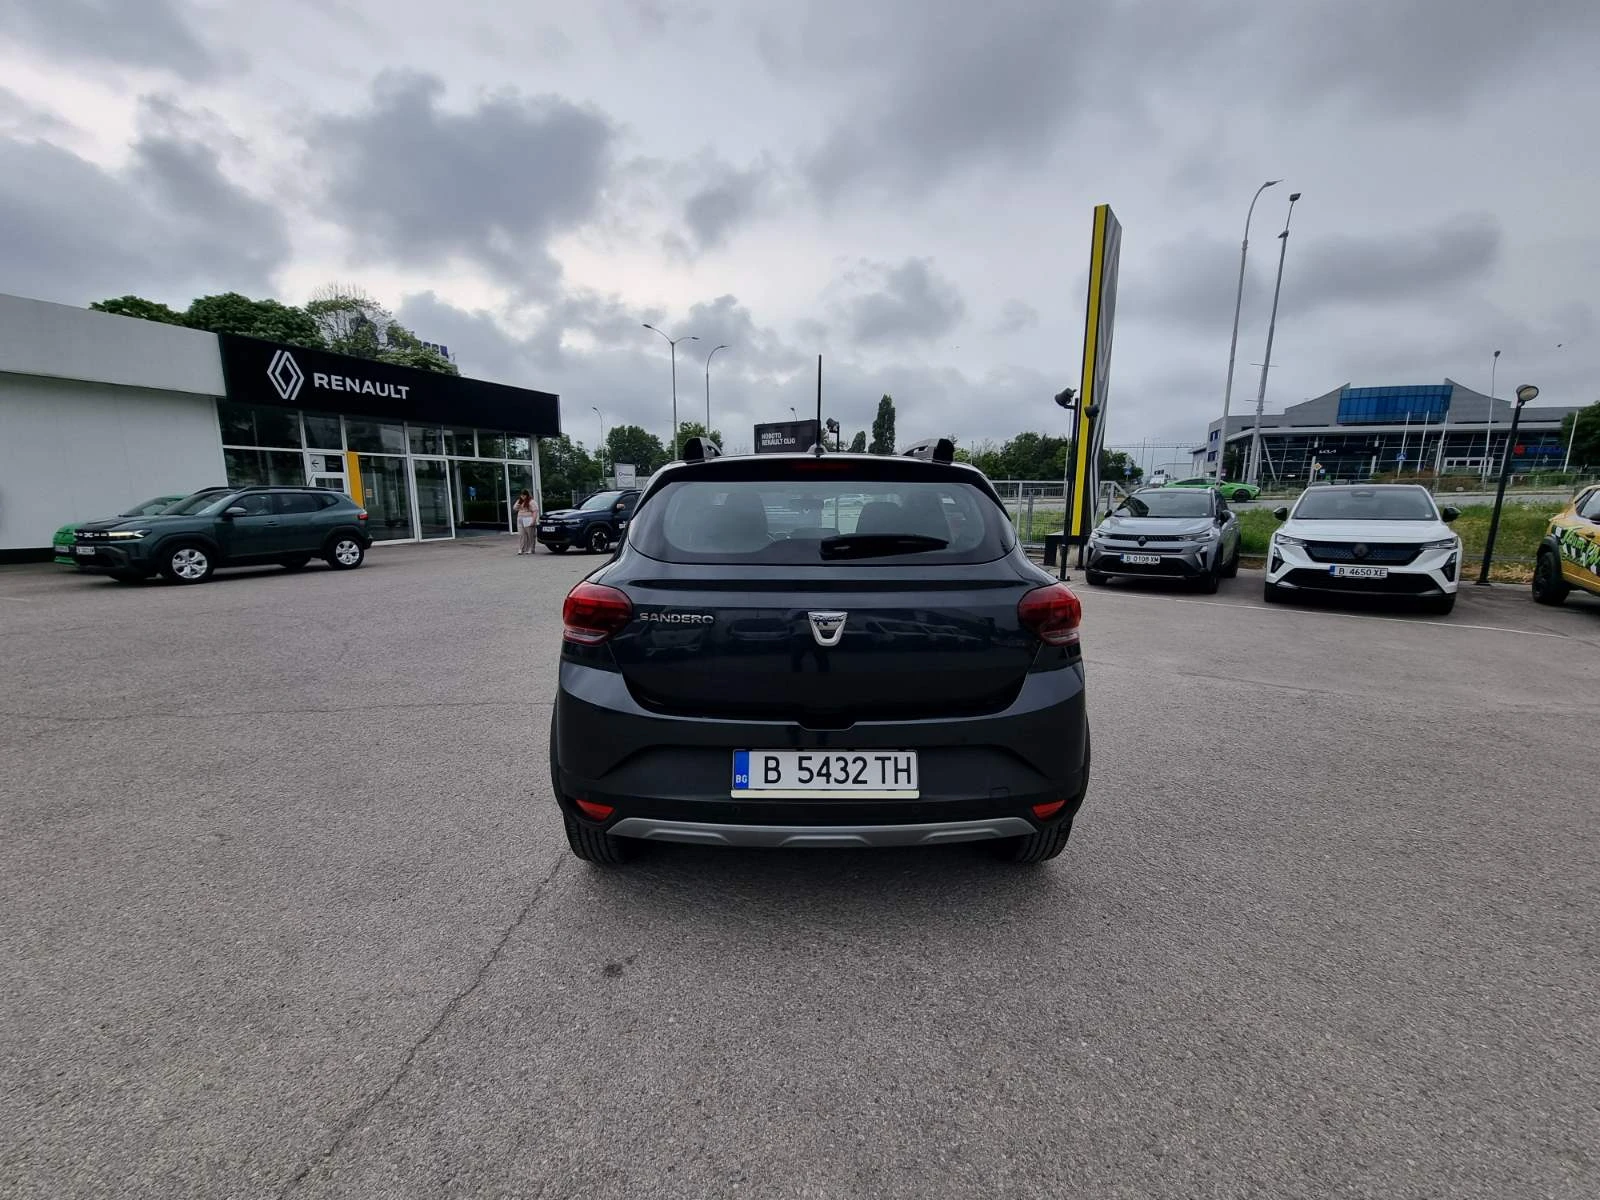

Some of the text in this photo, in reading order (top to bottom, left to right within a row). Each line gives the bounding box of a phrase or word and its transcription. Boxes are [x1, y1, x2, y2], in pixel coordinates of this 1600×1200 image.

[313, 372, 410, 400] RENAULT
[761, 437, 796, 446] RENAULT CLIO
[1349, 568, 1372, 576] 4650
[1373, 568, 1386, 577] XE
[640, 612, 714, 624] SANDERO
[764, 756, 912, 785] B 5432 TH
[735, 775, 748, 784] BG
